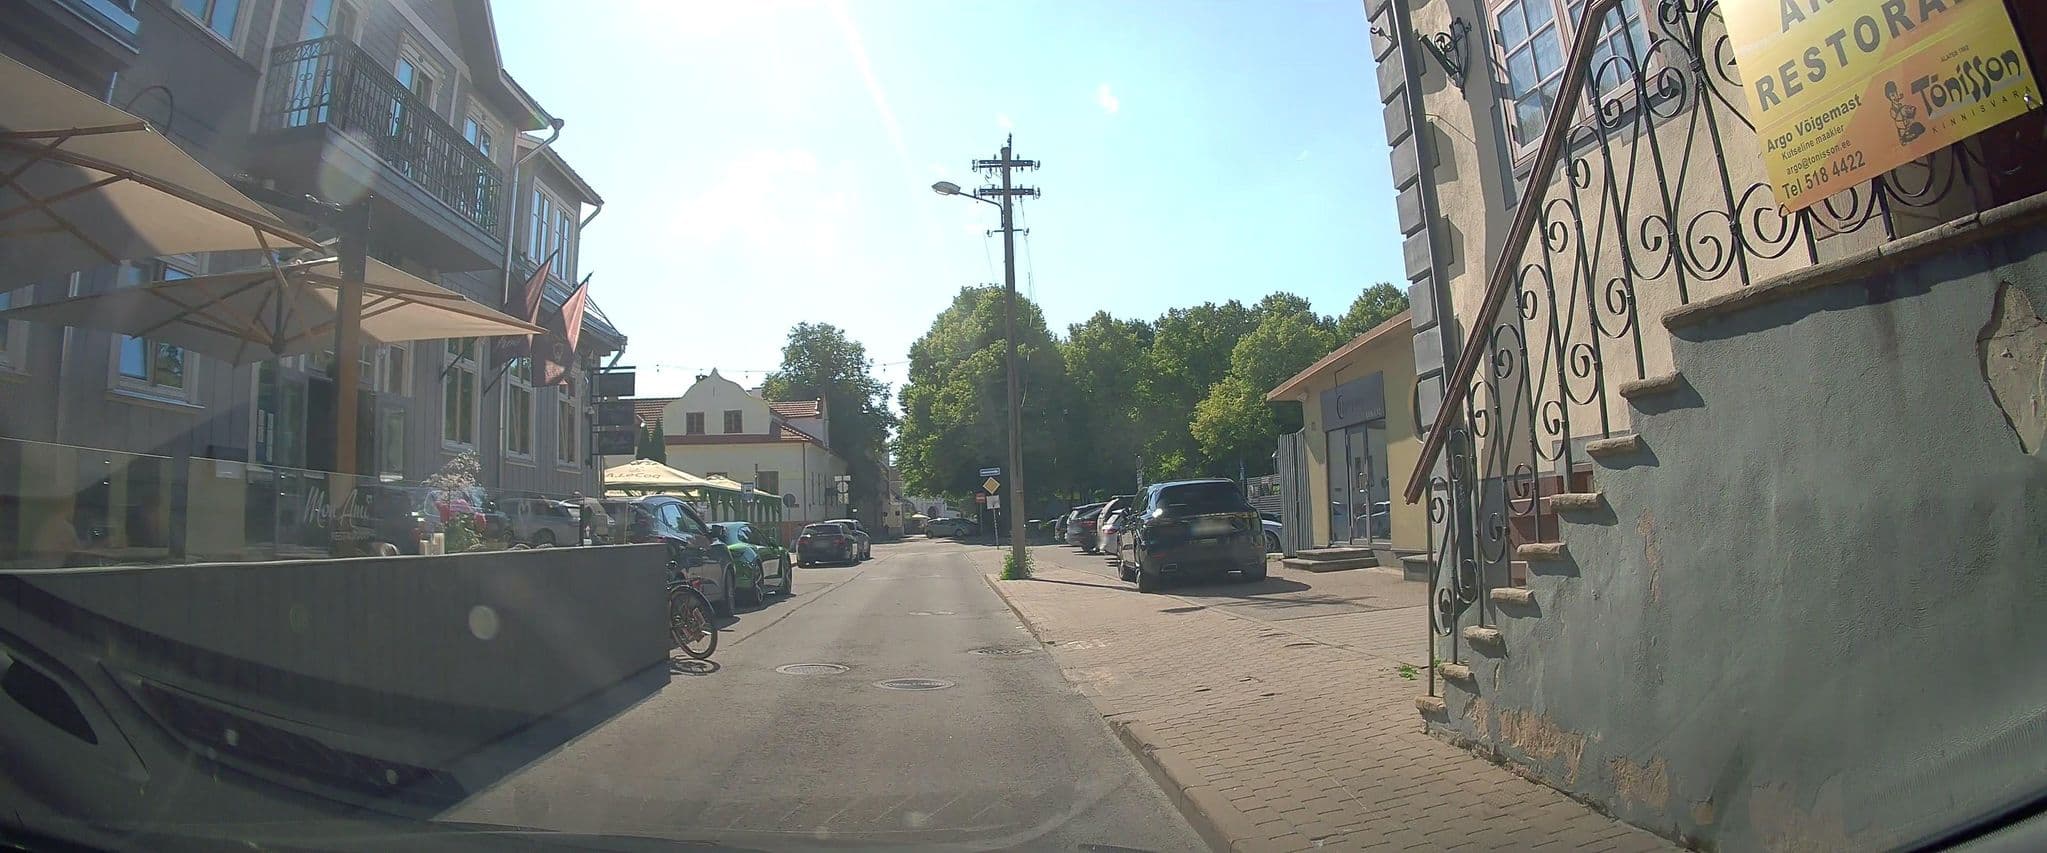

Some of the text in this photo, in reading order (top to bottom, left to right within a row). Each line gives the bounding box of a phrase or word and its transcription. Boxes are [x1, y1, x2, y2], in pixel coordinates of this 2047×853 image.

[1755, 0, 1962, 112] RESTORA
[1767, 94, 1862, 153] Argo Võigemast
[1932, 86, 2032, 134] KINNISVARA
[1781, 124, 1845, 161] Kutseline maakler
[1786, 140, 1852, 176] argo@tonisson.ee
[1782, 150, 1866, 199] Tel 518 4422
[303, 486, 373, 528] Mon Ami
